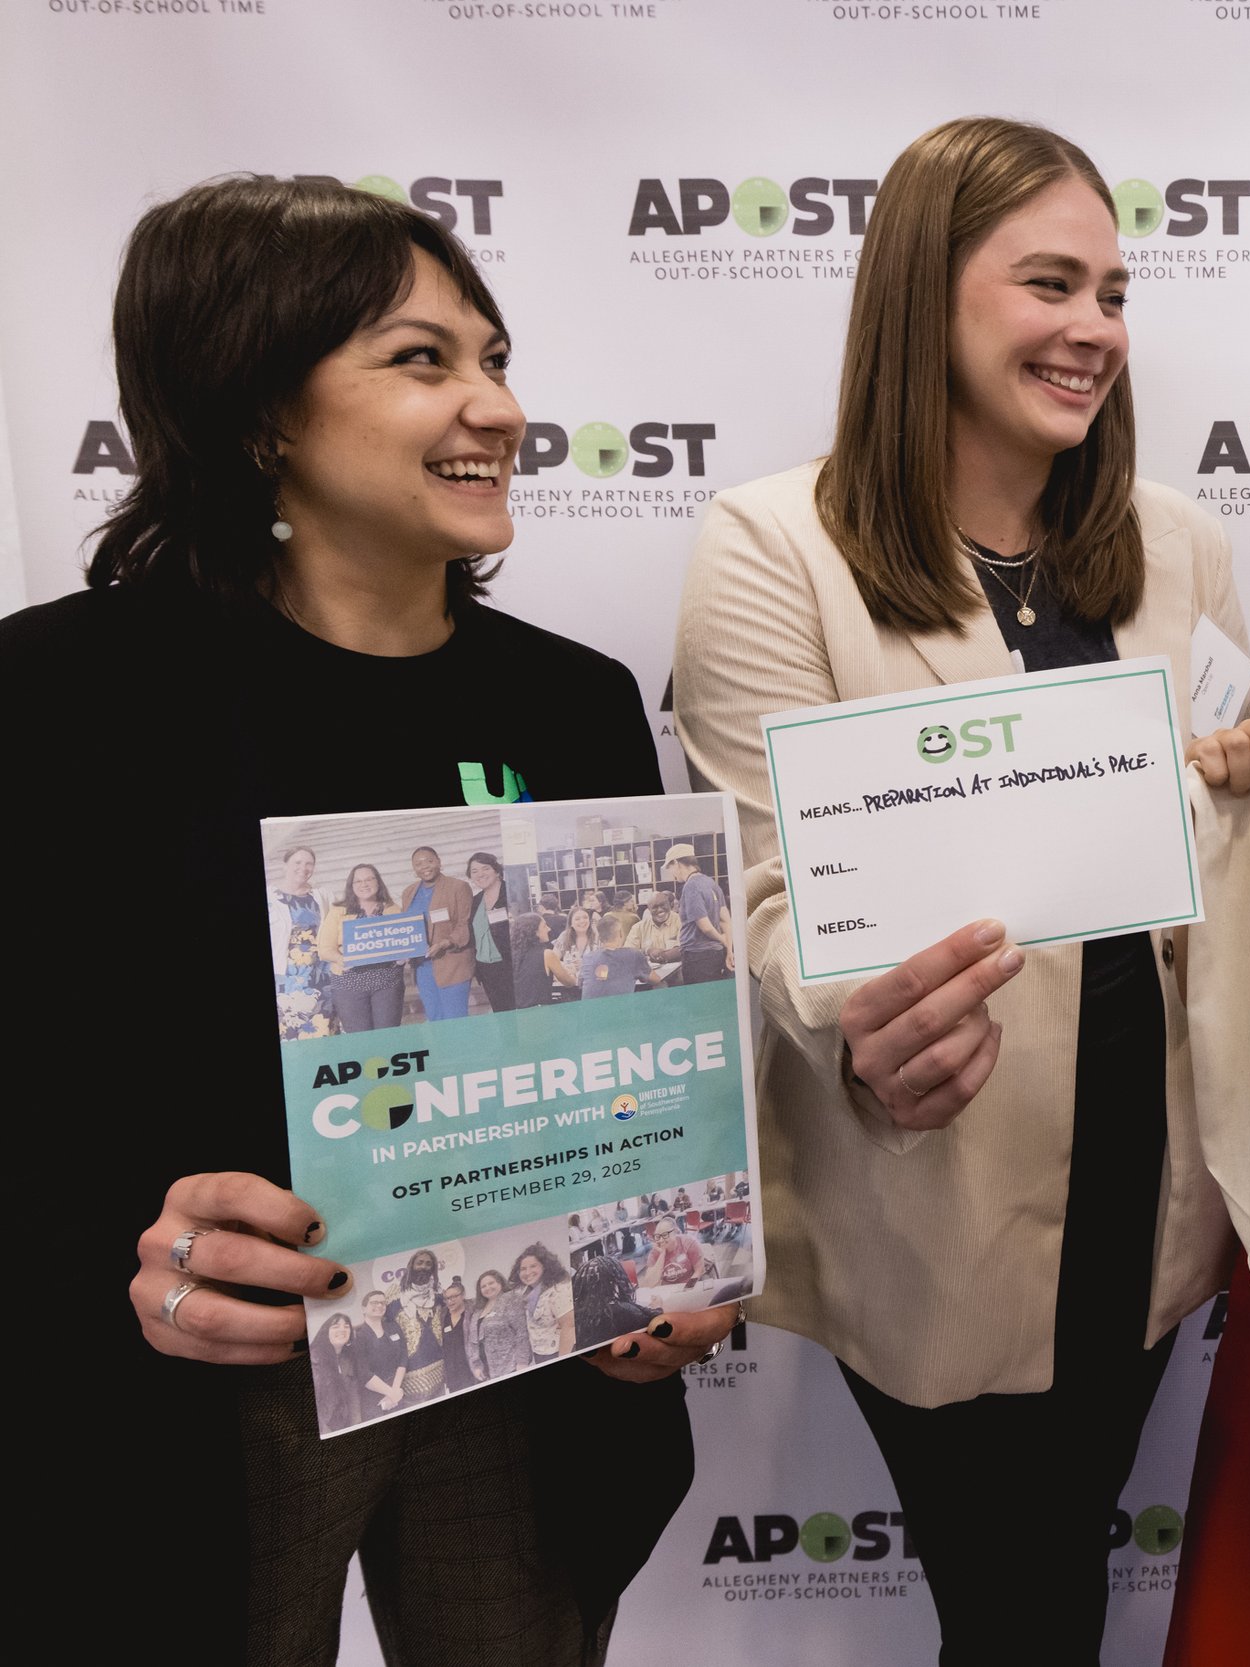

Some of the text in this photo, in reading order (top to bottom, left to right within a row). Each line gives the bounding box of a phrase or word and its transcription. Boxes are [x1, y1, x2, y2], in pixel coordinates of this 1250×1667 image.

[49, 0, 266, 15] OUT-OF-SCHOOL TIME
[449, 4, 657, 19] OUT-OF-SCHOOL TIME
[833, 5, 1041, 20] OUT-OF-SCHOOL TIME
[628, 176, 878, 238] APOST
[630, 249, 863, 264] ALLEGHENY PARTNERS FO
[1216, 249, 1250, 262] FOR
[655, 266, 856, 280] OUT-OF-SCHOOL TIME
[1184, 266, 1227, 279] TIME
[512, 421, 716, 478] POST
[509, 489, 572, 502] GHENY
[582, 490, 674, 502] PARTNERS
[653, 506, 695, 518] TIME
[917, 713, 1024, 764] OST
[862, 777, 966, 813] PREPARATION
[971, 773, 992, 797] AT
[354, 925, 415, 940] Let's Keep
[347, 937, 410, 954] BOOSTing
[312, 1049, 430, 1089] APOST
[312, 1031, 727, 1140] CONFERENCE
[639, 1084, 686, 1102] UNITED WAY
[648, 1095, 690, 1109] Southwestern
[640, 1104, 681, 1118] Pennsylvania
[372, 1105, 605, 1164] IN PARTNERSHIP WITH
[392, 1126, 685, 1200] OST PARTNERSHIPS IN ACTION
[451, 1158, 641, 1213] SEPTEMBER 29, 2025
[726, 1363, 757, 1373] FOR
[697, 1377, 736, 1388] TIME
[702, 1574, 801, 1588] ALLEGHENY
[808, 1571, 890, 1584] PARTNERS
[724, 1586, 908, 1601] OUT-OF-SCHOOL TIME
